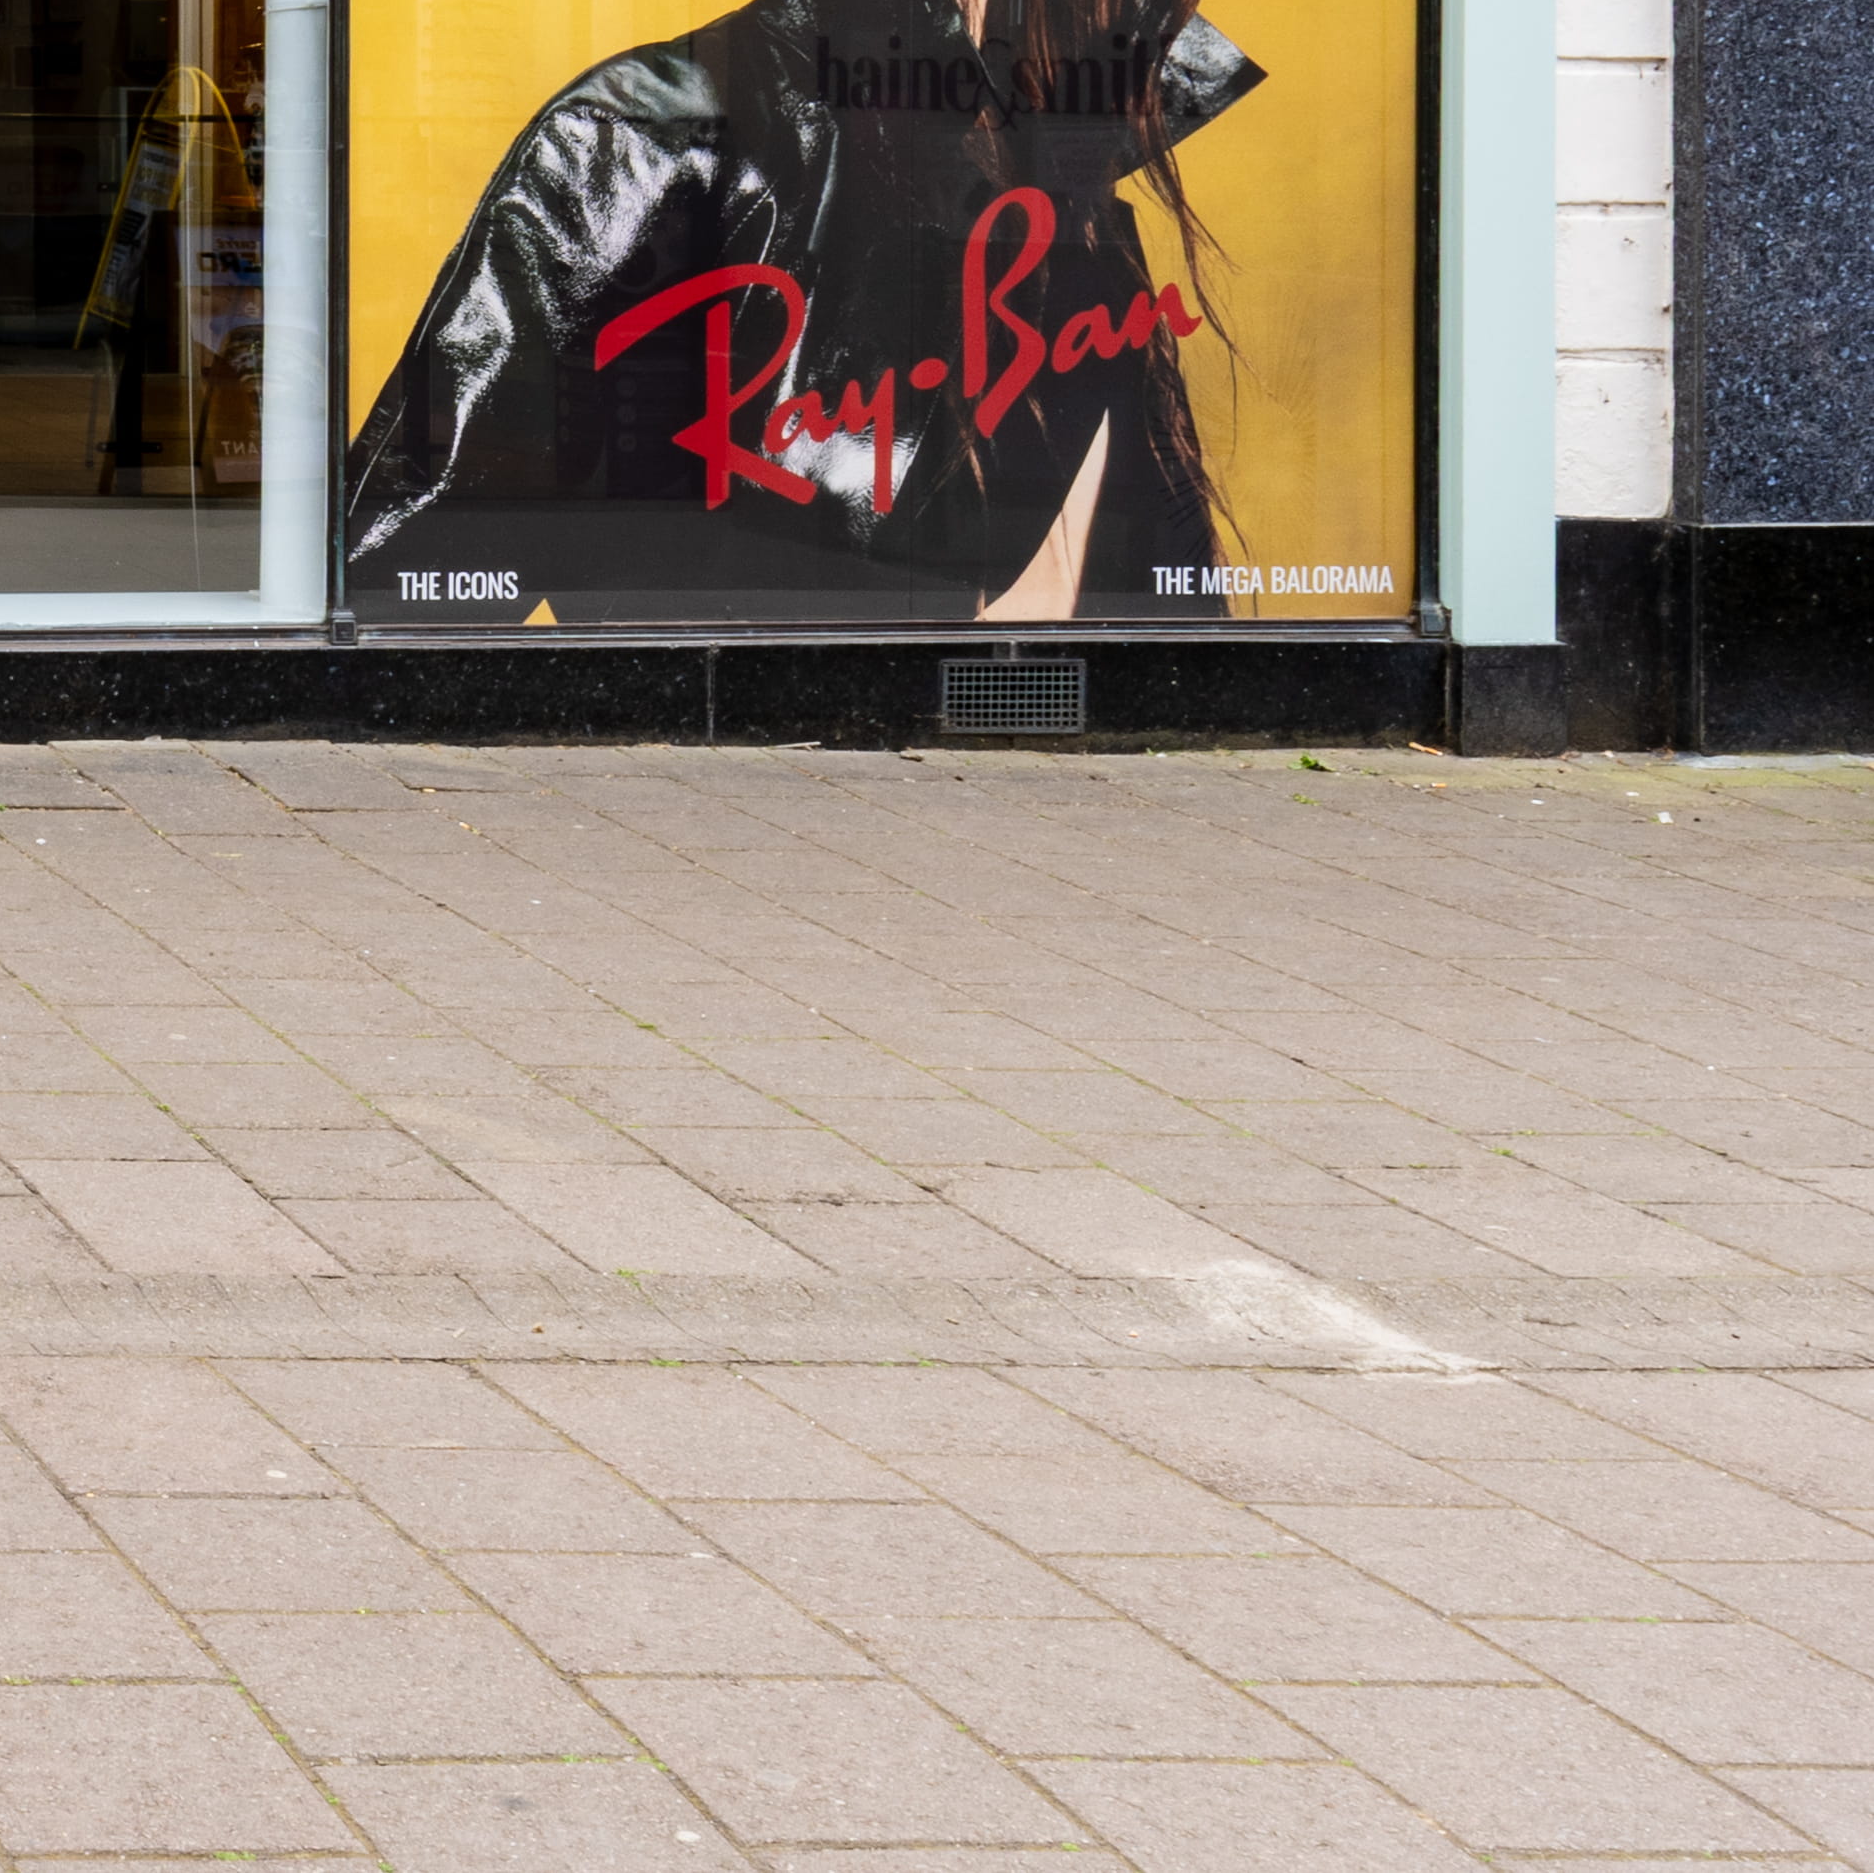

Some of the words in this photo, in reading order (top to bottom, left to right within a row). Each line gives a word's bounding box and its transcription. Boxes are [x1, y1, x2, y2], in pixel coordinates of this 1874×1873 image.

[397, 572, 441, 600] THE
[448, 571, 519, 600] ICONS
[1152, 566, 1196, 595] THE
[1201, 566, 1264, 594] MEGA
[1271, 565, 1394, 594] BALORAMA
